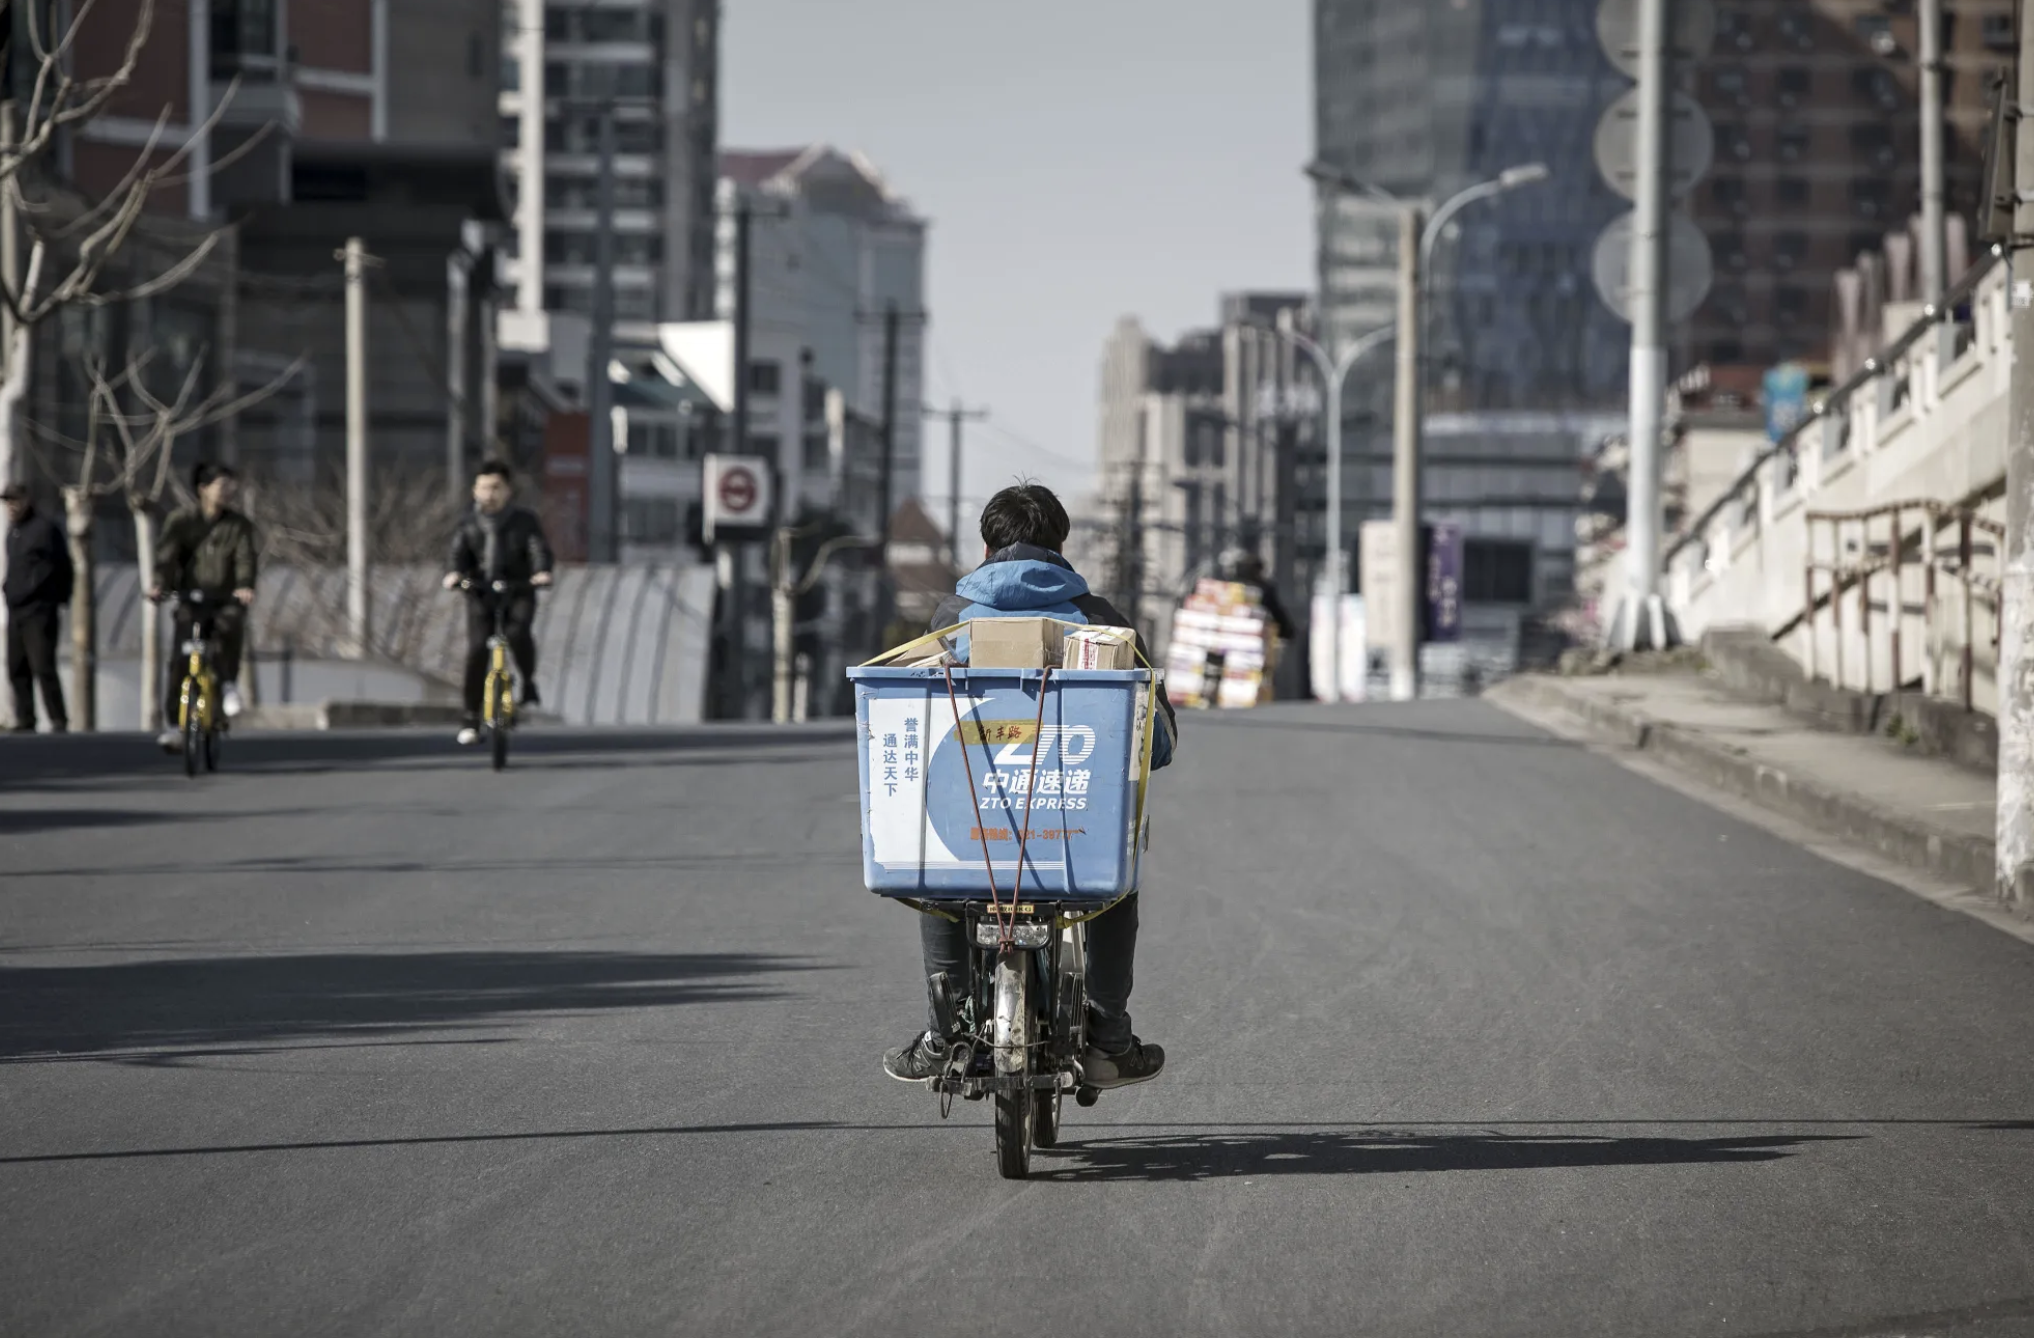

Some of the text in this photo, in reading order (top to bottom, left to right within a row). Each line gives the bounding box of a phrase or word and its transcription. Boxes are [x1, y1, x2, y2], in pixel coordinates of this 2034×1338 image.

[883, 733, 898, 797] 通达天下
[904, 717, 919, 782] 誉满中华
[993, 724, 1096, 765] ZTO
[983, 768, 1092, 795] 中通速递
[979, 797, 1087, 810] ZTO EXPRESS
